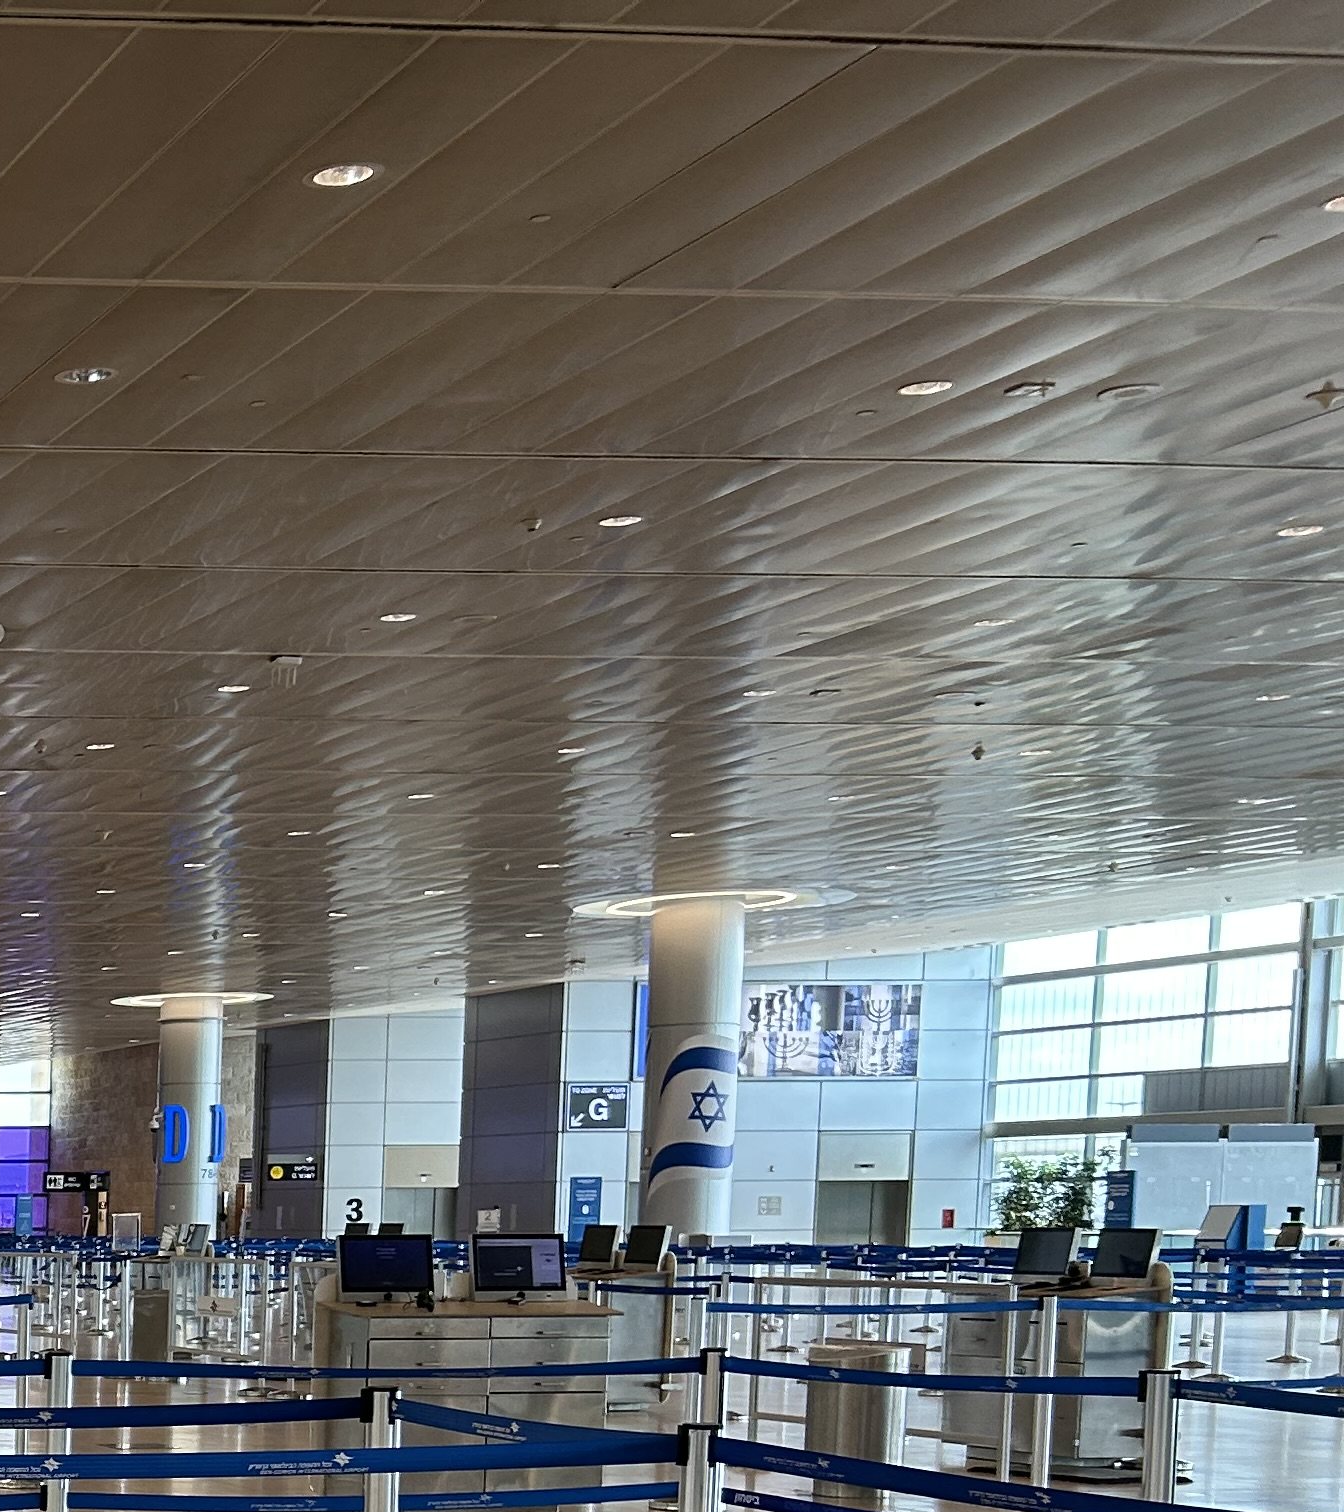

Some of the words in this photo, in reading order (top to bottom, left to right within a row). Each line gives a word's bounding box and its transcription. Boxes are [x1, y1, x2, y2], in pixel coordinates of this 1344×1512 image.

[589, 1098, 608, 1120] G
[162, 1104, 190, 1163] D
[346, 1198, 363, 1222] 3
[484, 1212, 492, 1221] 2
